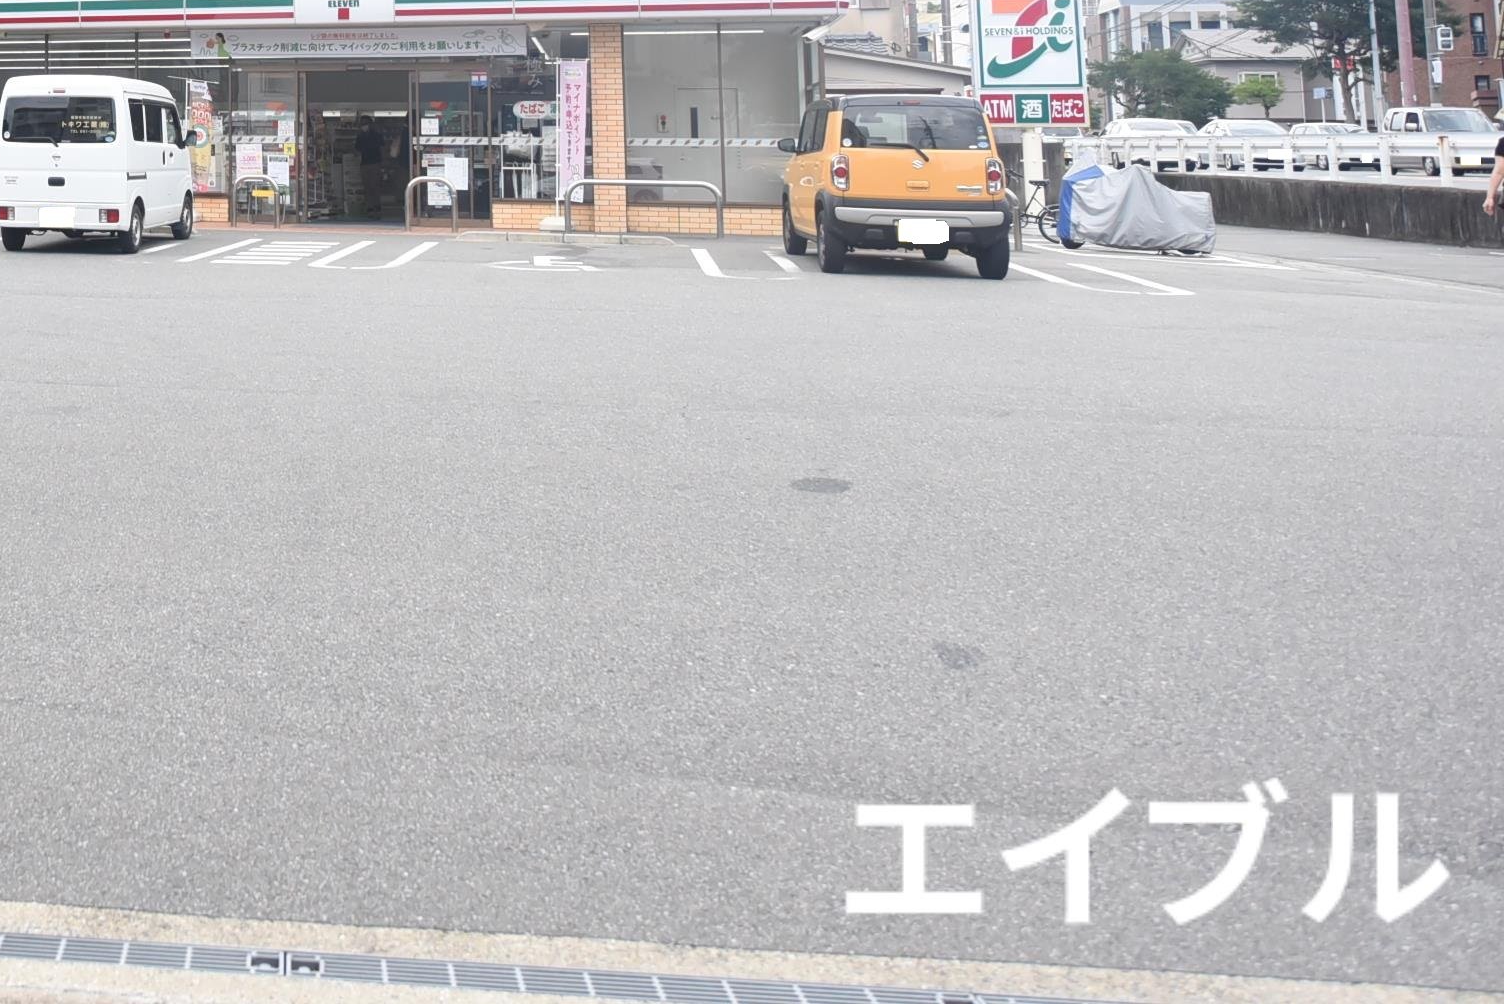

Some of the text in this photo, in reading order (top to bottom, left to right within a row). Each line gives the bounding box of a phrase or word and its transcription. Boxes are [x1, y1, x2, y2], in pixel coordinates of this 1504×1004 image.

[231, 40, 486, 52] プラスチック削減に向けて、マイバッグのご利用をお願いします。
[520, 103, 545, 114] たばこ
[983, 99, 1013, 119] ATM
[1021, 99, 1043, 119] 酒
[1051, 98, 1084, 118] たばこ
